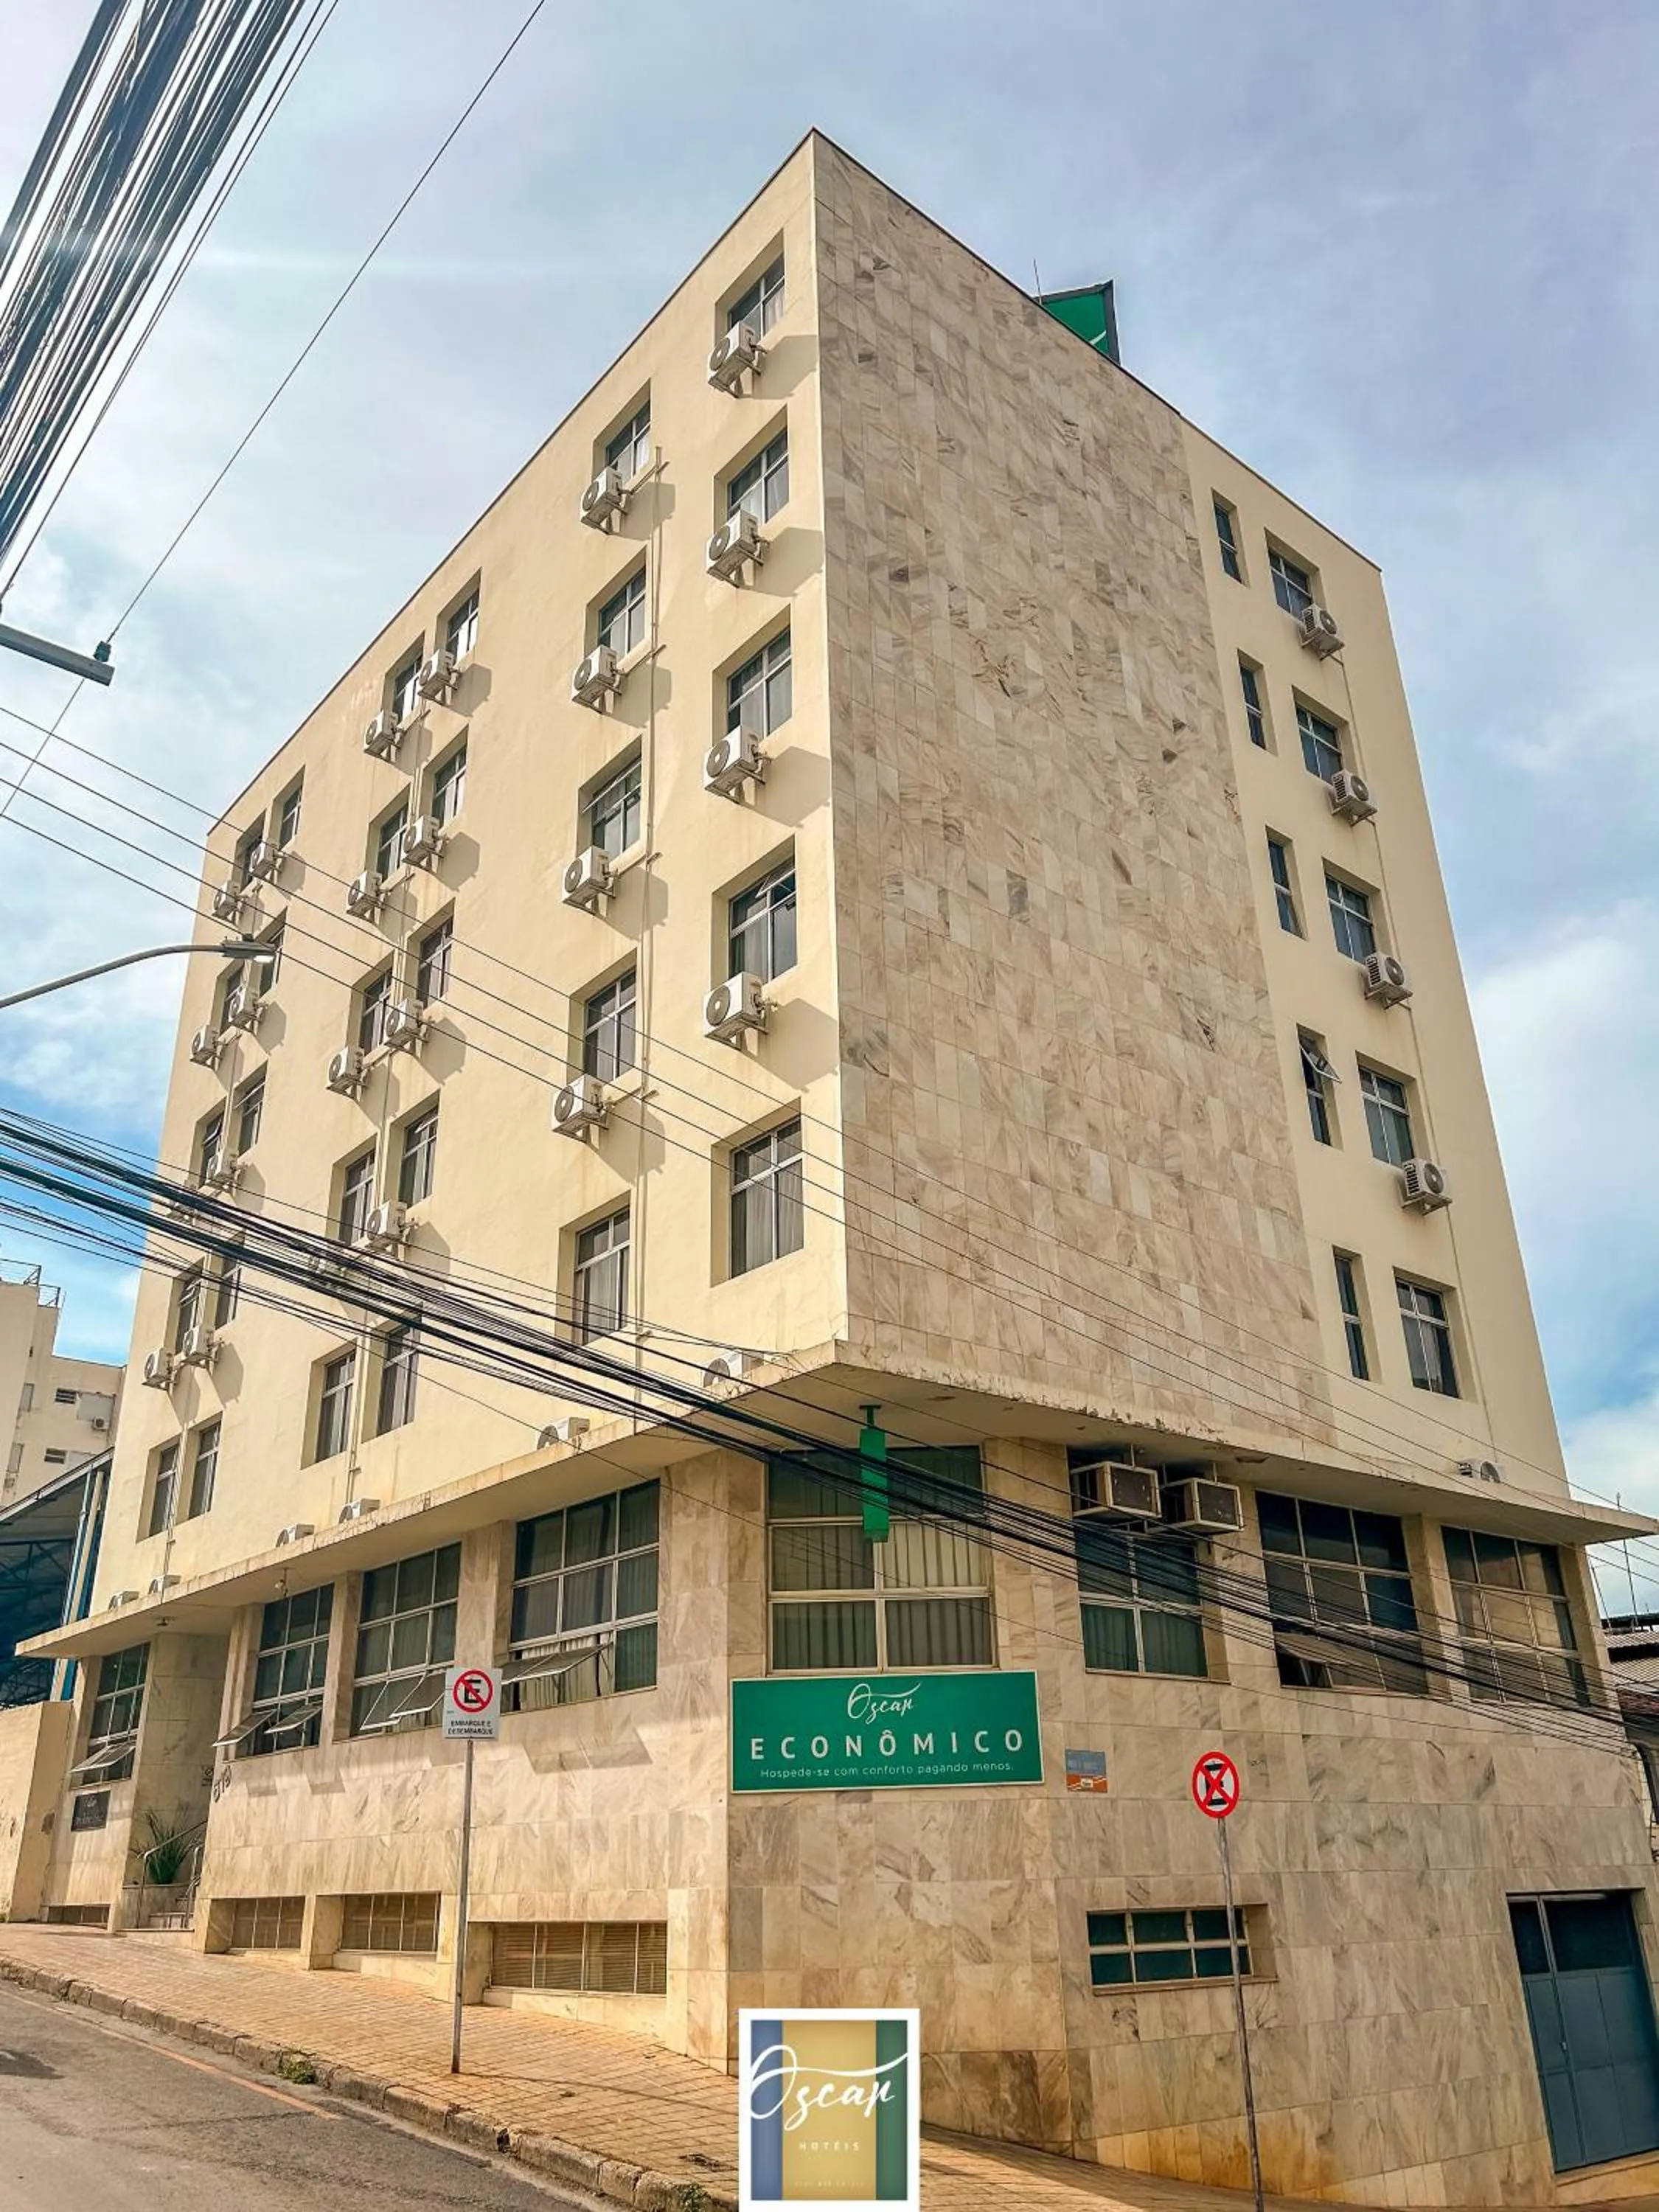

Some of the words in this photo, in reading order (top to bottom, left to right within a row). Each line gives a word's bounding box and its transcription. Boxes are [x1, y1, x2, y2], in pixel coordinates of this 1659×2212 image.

[848, 1683, 921, 1725] Oscar
[751, 1730, 1023, 1761] ECONÔMICO
[761, 1767, 830, 1778] Hospede-se
[834, 1768, 859, 1776] com
[862, 1764, 913, 1775] conforto
[918, 1763, 968, 1775] pagando
[973, 1762, 1014, 1771] menos.
